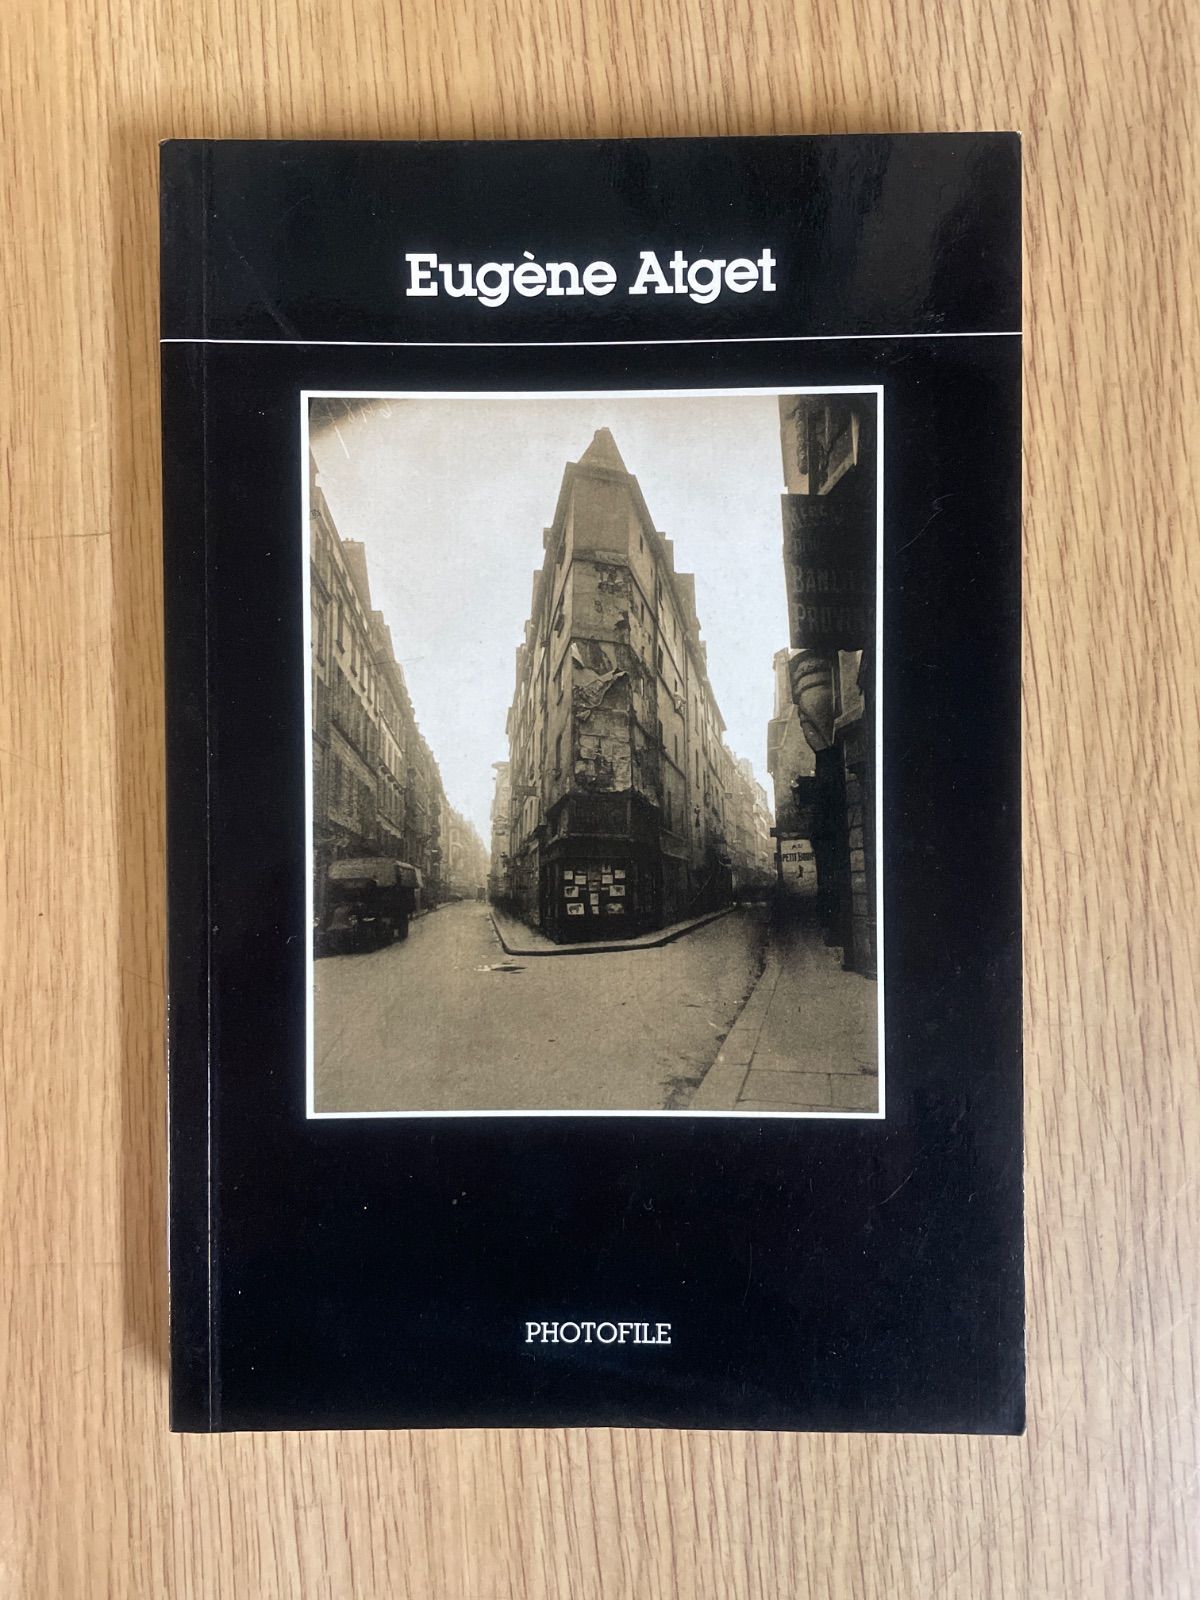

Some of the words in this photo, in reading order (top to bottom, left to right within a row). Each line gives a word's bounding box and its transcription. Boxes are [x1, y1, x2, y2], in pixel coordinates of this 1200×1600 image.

[405, 250, 617, 307] Eugène
[629, 248, 776, 304] Atget
[525, 1322, 672, 1344] PHOTOFILE
